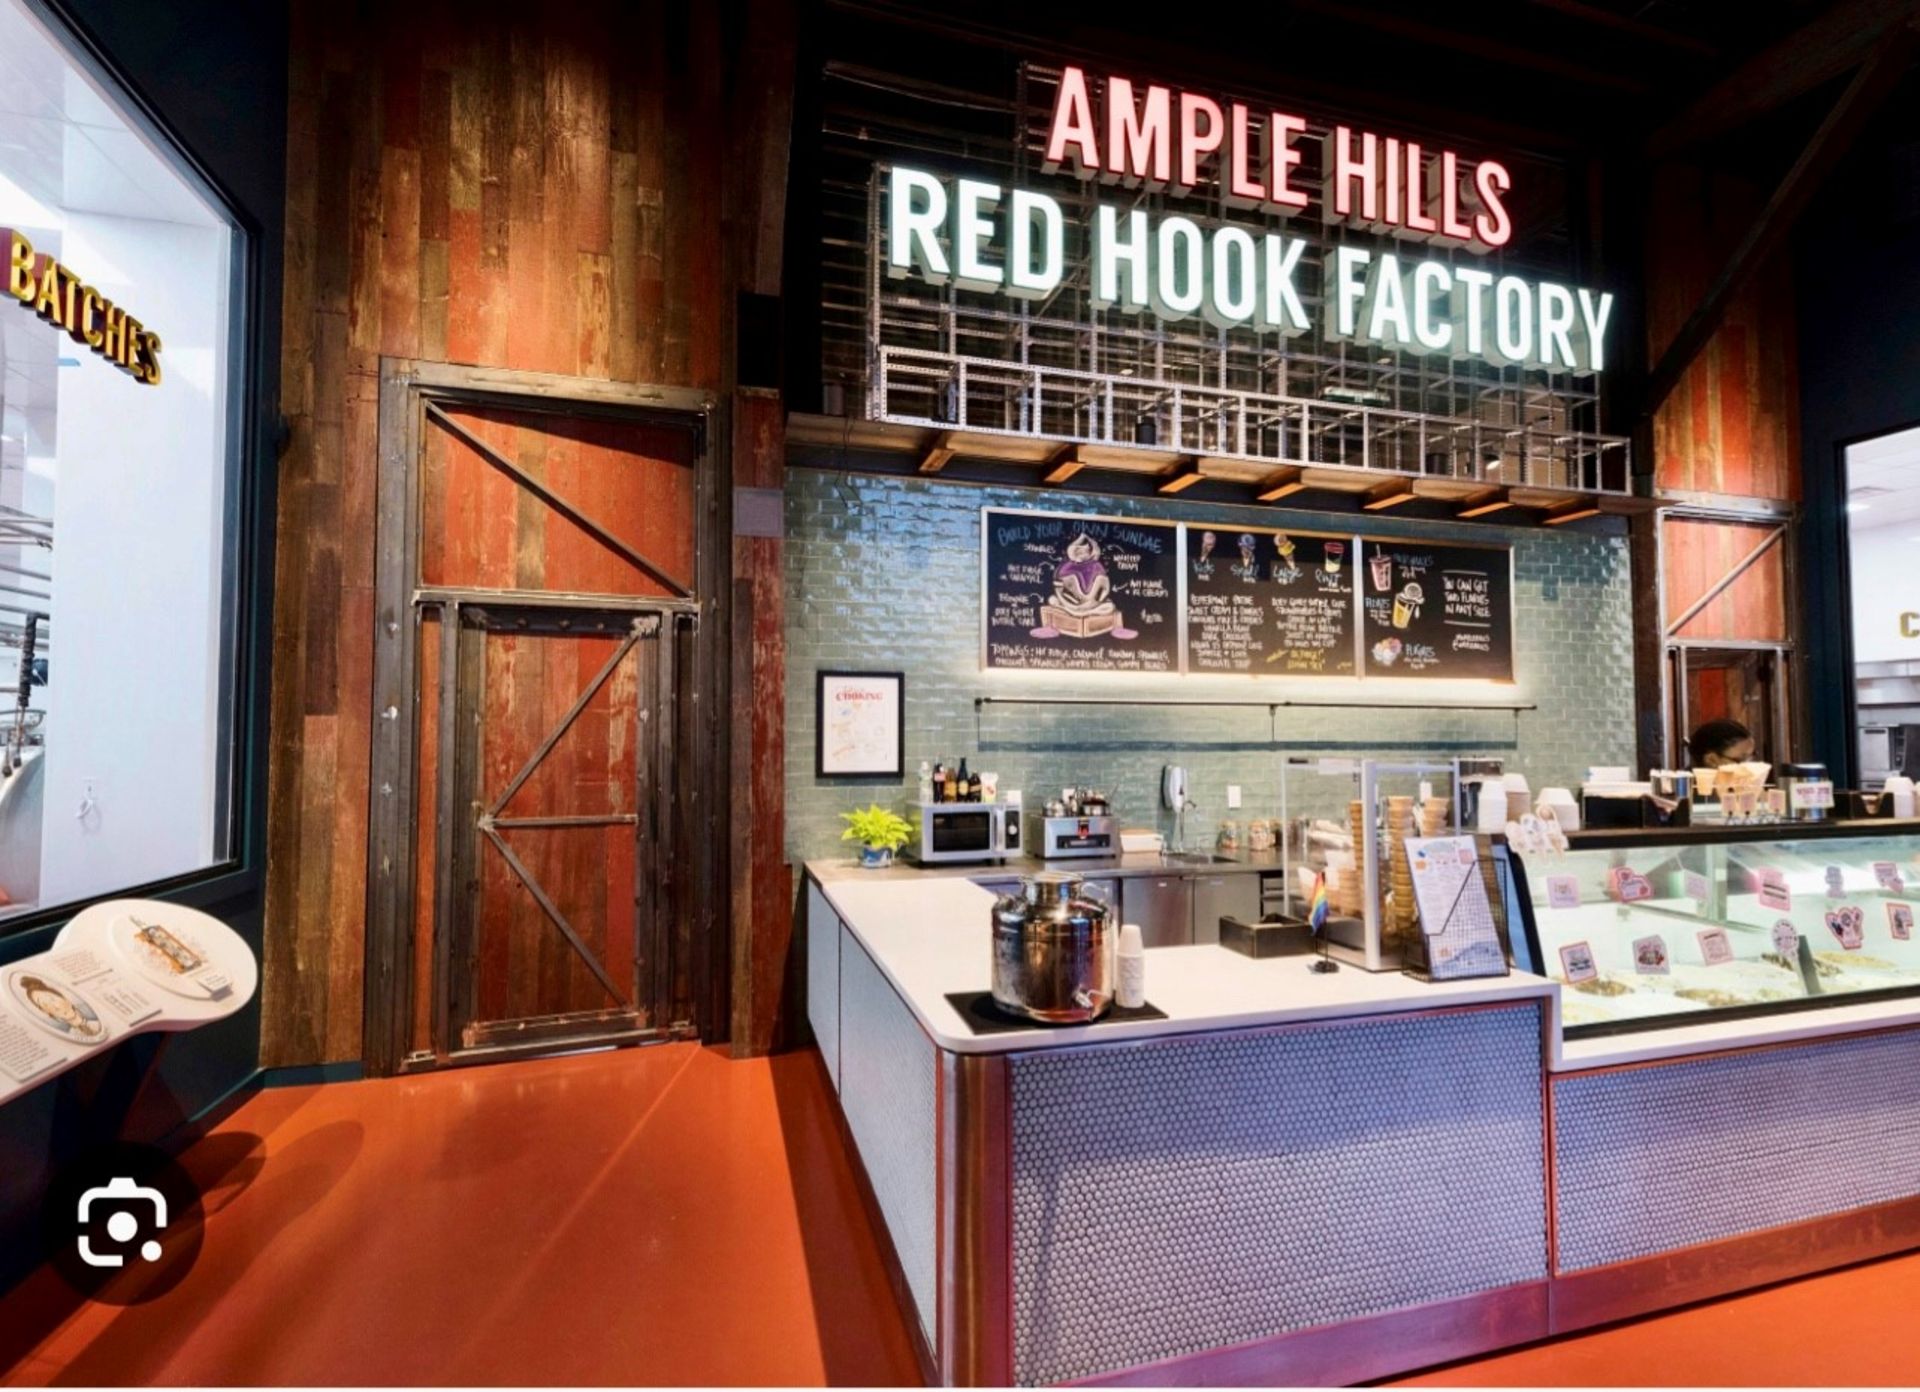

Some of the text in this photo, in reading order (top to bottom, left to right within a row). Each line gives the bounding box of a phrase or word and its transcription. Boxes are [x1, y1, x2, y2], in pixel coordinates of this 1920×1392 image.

[1047, 66, 1512, 247] AMPLE HILLS
[9, 229, 163, 386] BATCHES
[891, 166, 1614, 372] RED HOOK FACTORY
